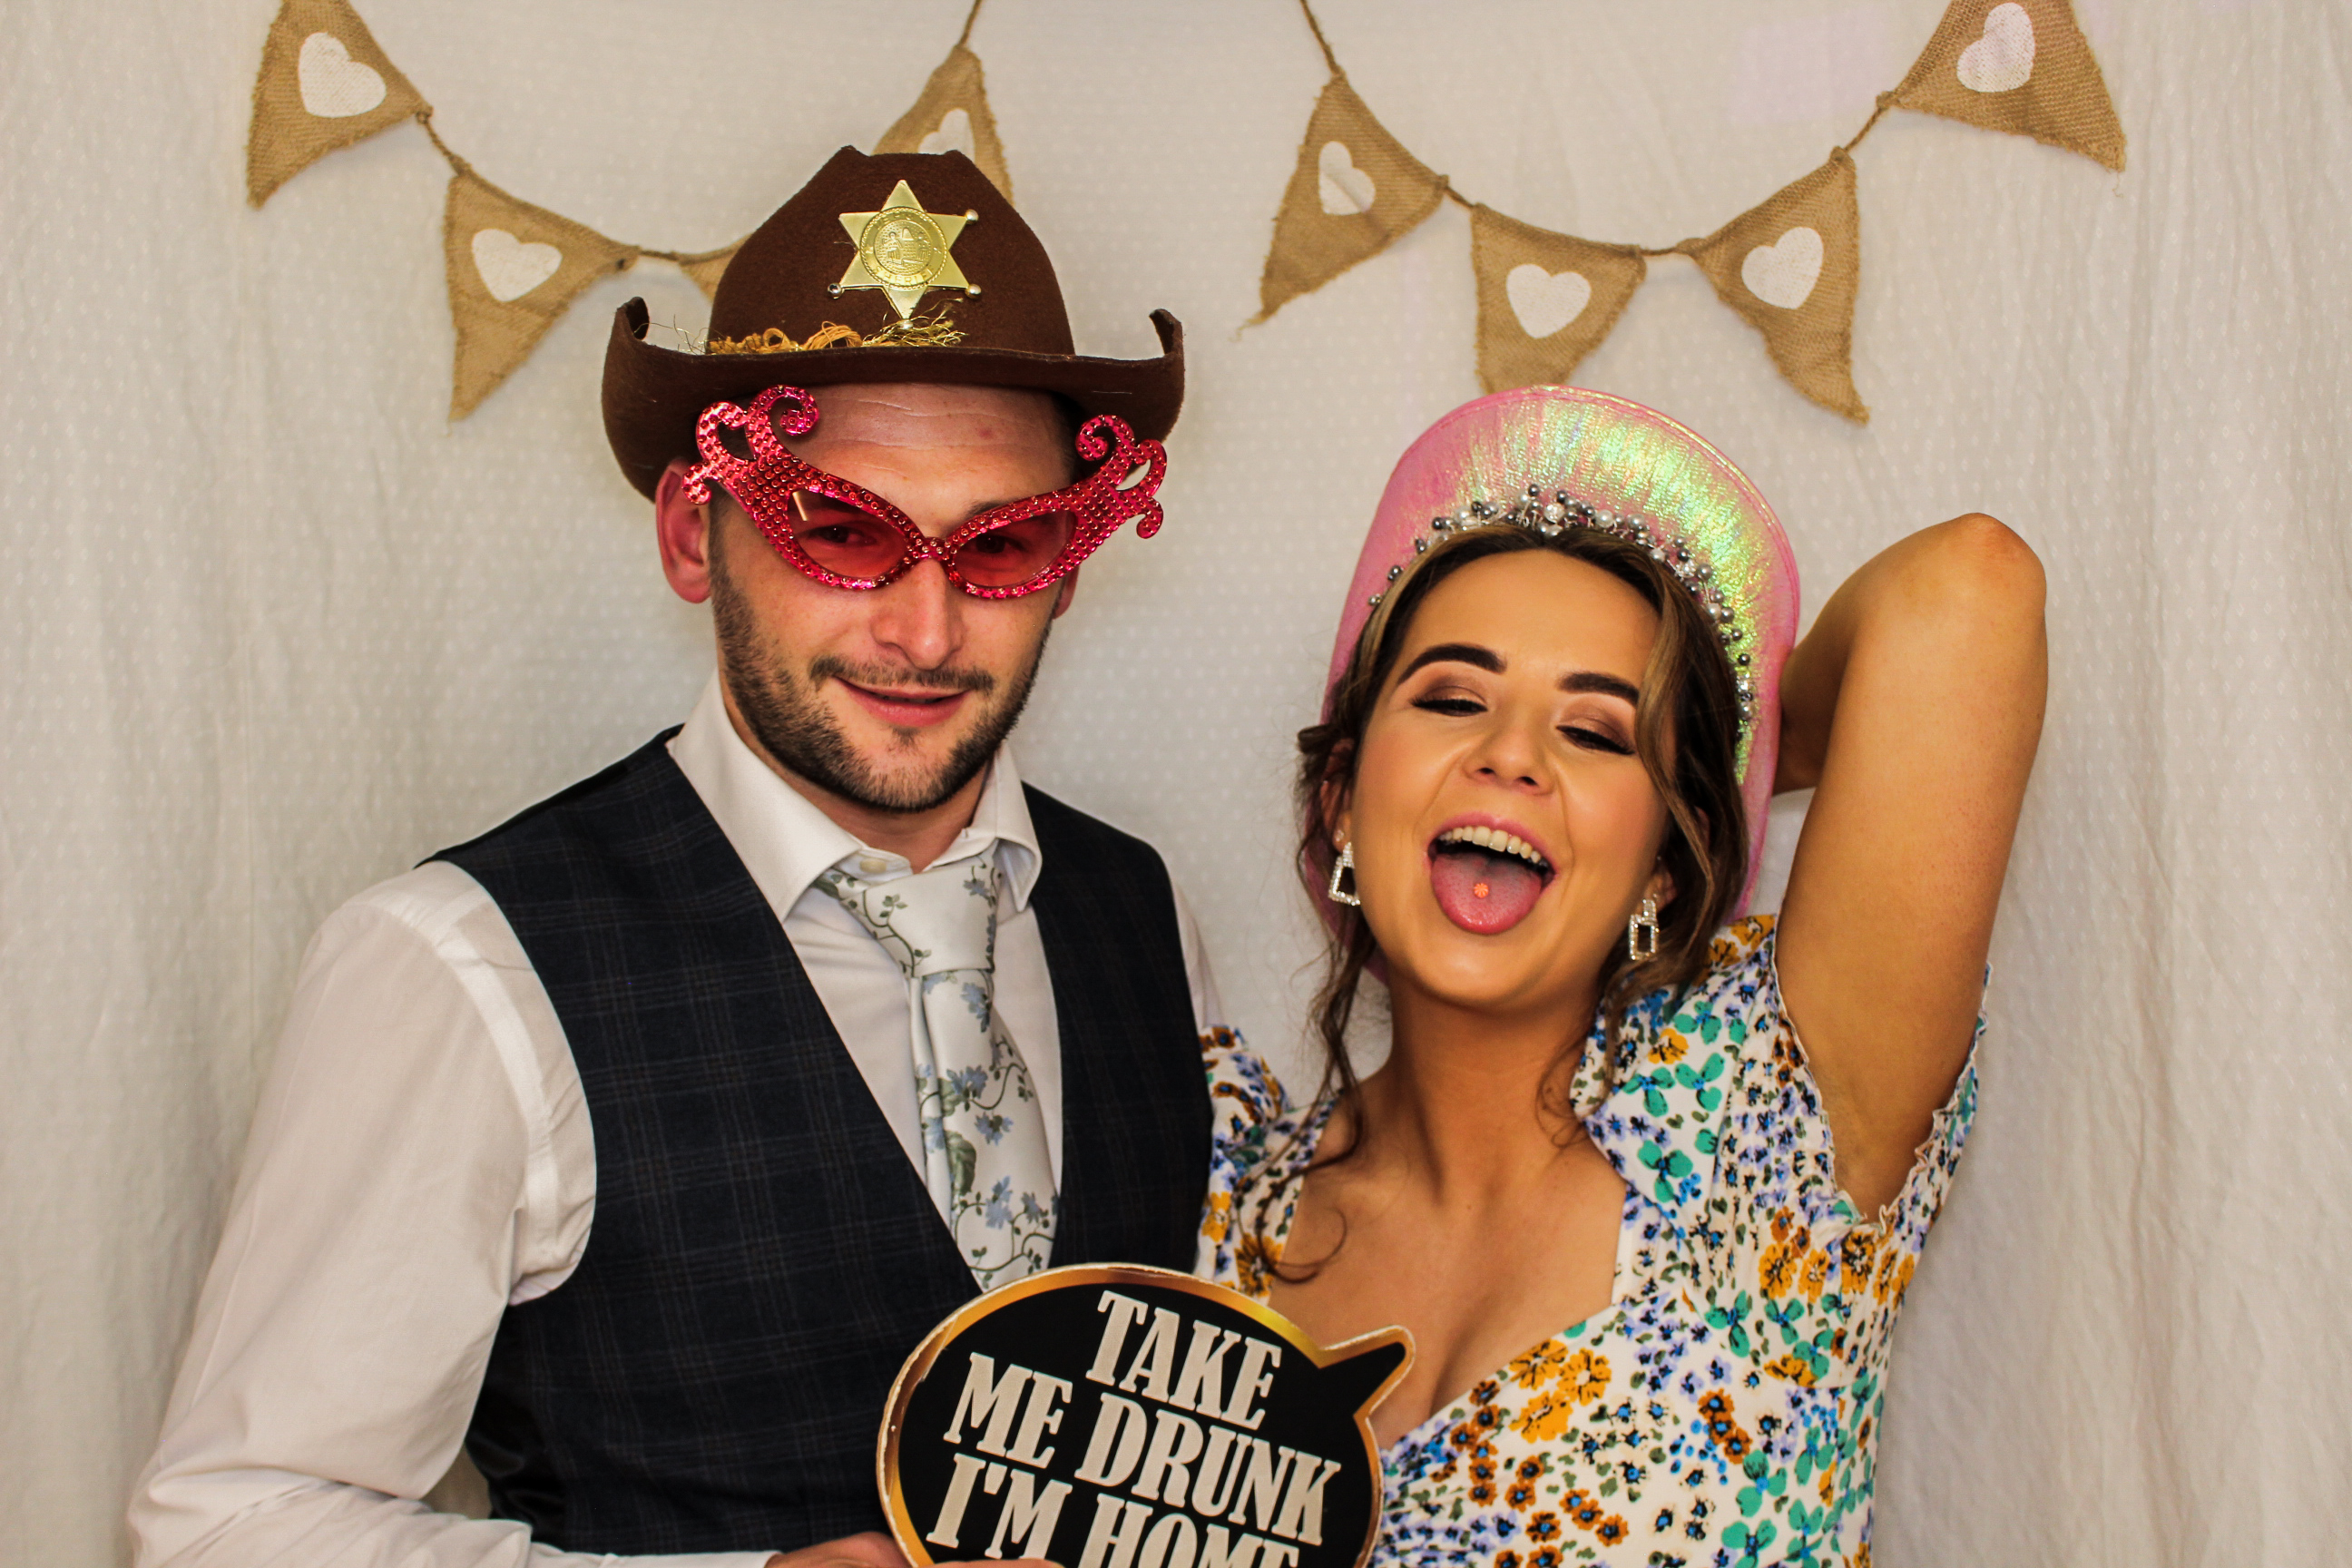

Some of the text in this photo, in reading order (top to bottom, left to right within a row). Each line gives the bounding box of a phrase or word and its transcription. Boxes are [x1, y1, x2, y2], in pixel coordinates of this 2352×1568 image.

[1086, 1290, 1281, 1430] TAKE
[926, 1453, 1298, 1567] I'M HO
[944, 1352, 1341, 1545] ME DRUNK
